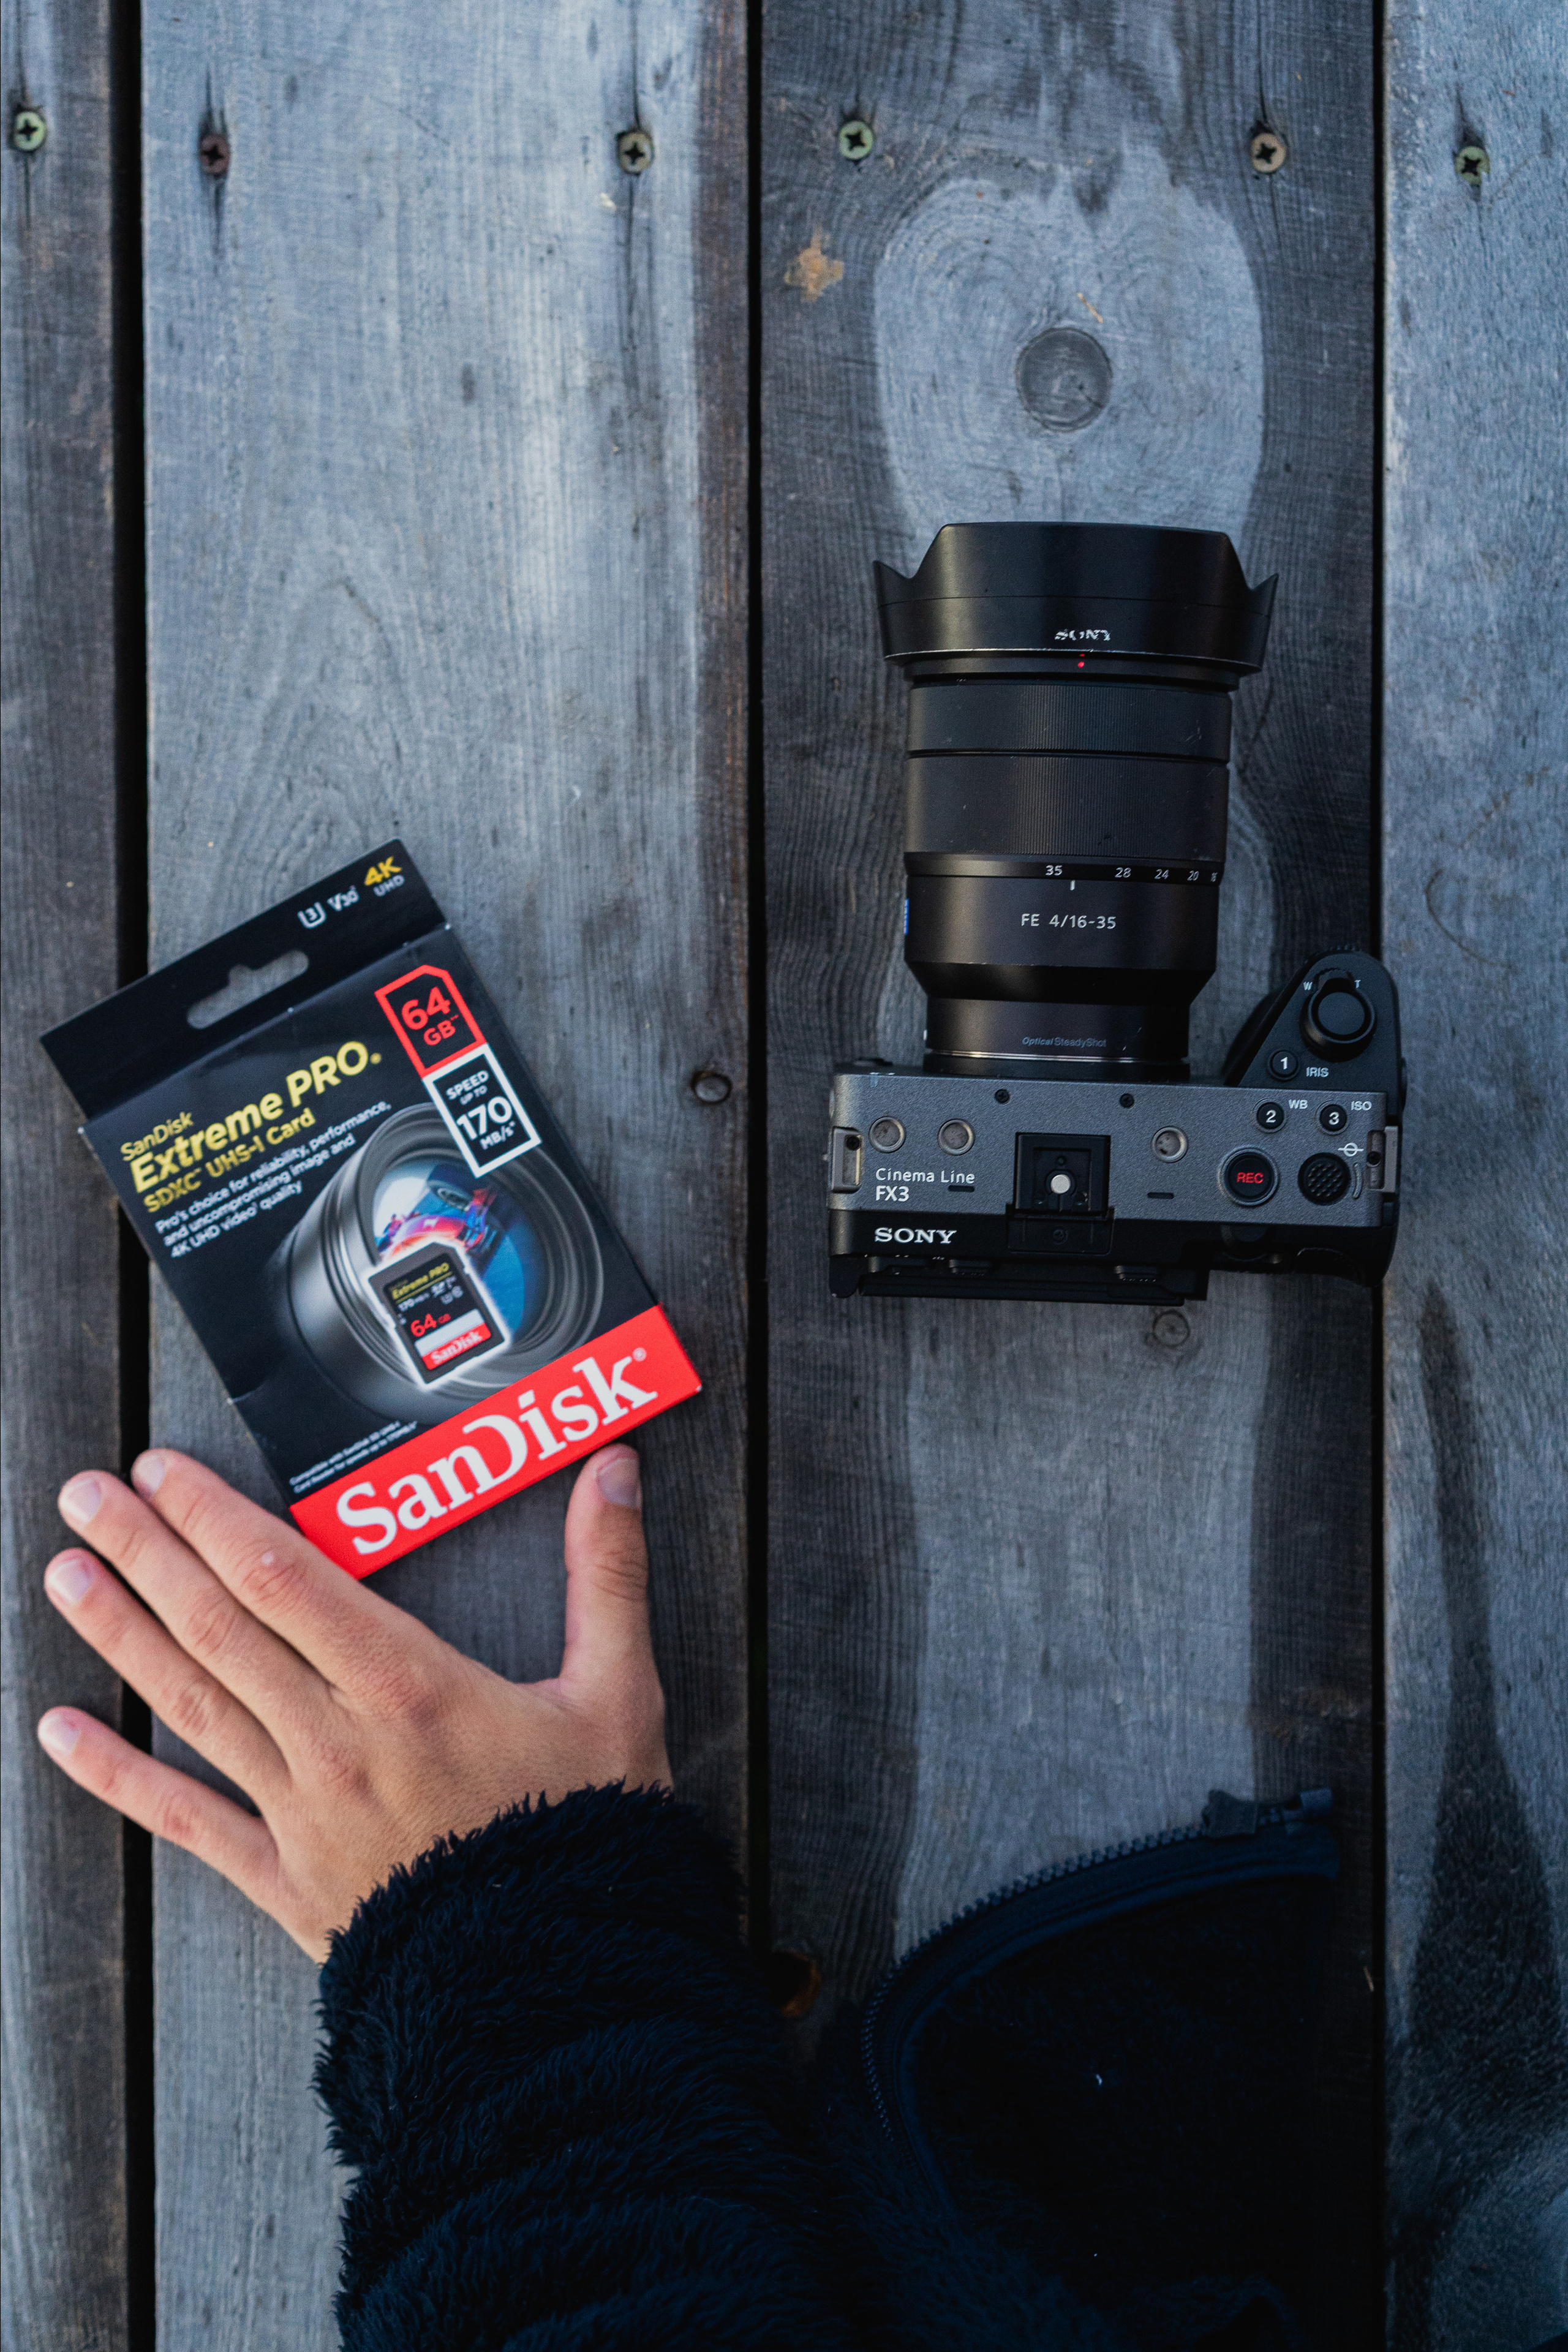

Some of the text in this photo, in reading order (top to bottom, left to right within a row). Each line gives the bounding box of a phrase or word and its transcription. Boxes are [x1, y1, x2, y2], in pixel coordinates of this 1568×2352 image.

[364, 856, 402, 886] 4K
[1045, 865, 1063, 876] 35
[1114, 867, 1132, 878] 28
[1154, 869, 1169, 880] 24
[1187, 870, 1199, 881] 20
[373, 875, 405, 897] UHD
[1020, 913, 1117, 929] FE 4/16-35
[1303, 981, 1313, 991] W
[1354, 979, 1361, 989] T
[401, 986, 451, 1030] 64
[1281, 1057, 1329, 1078] 1 IRIS
[445, 1070, 490, 1101] SPEED
[459, 1085, 488, 1105] UP TO
[1288, 1099, 1308, 1110] WB
[1351, 1101, 1373, 1111] ISO
[456, 1096, 512, 1140] 170
[1265, 1109, 1276, 1123] 2
[1329, 1112, 1340, 1126] 3
[121, 1112, 194, 1161] SanDisk
[130, 1093, 284, 1193] Extreme
[205, 1135, 265, 1177] UHS-I
[266, 1107, 316, 1145] Card
[155, 1101, 392, 1234] Pro's choice for reliability, performance,
[875, 1167, 976, 1184] Cinema Line
[1237, 1172, 1264, 1184] REC
[163, 1133, 356, 1246] and uncompromising image and
[875, 1185, 910, 1202] FX3
[171, 1240, 192, 1257] 4K
[189, 1224, 221, 1248] UHD
[259, 1180, 303, 1211] quality
[875, 1227, 957, 1245] SONY
[410, 1313, 437, 1336] 64
[430, 1331, 483, 1365] SanDisk
